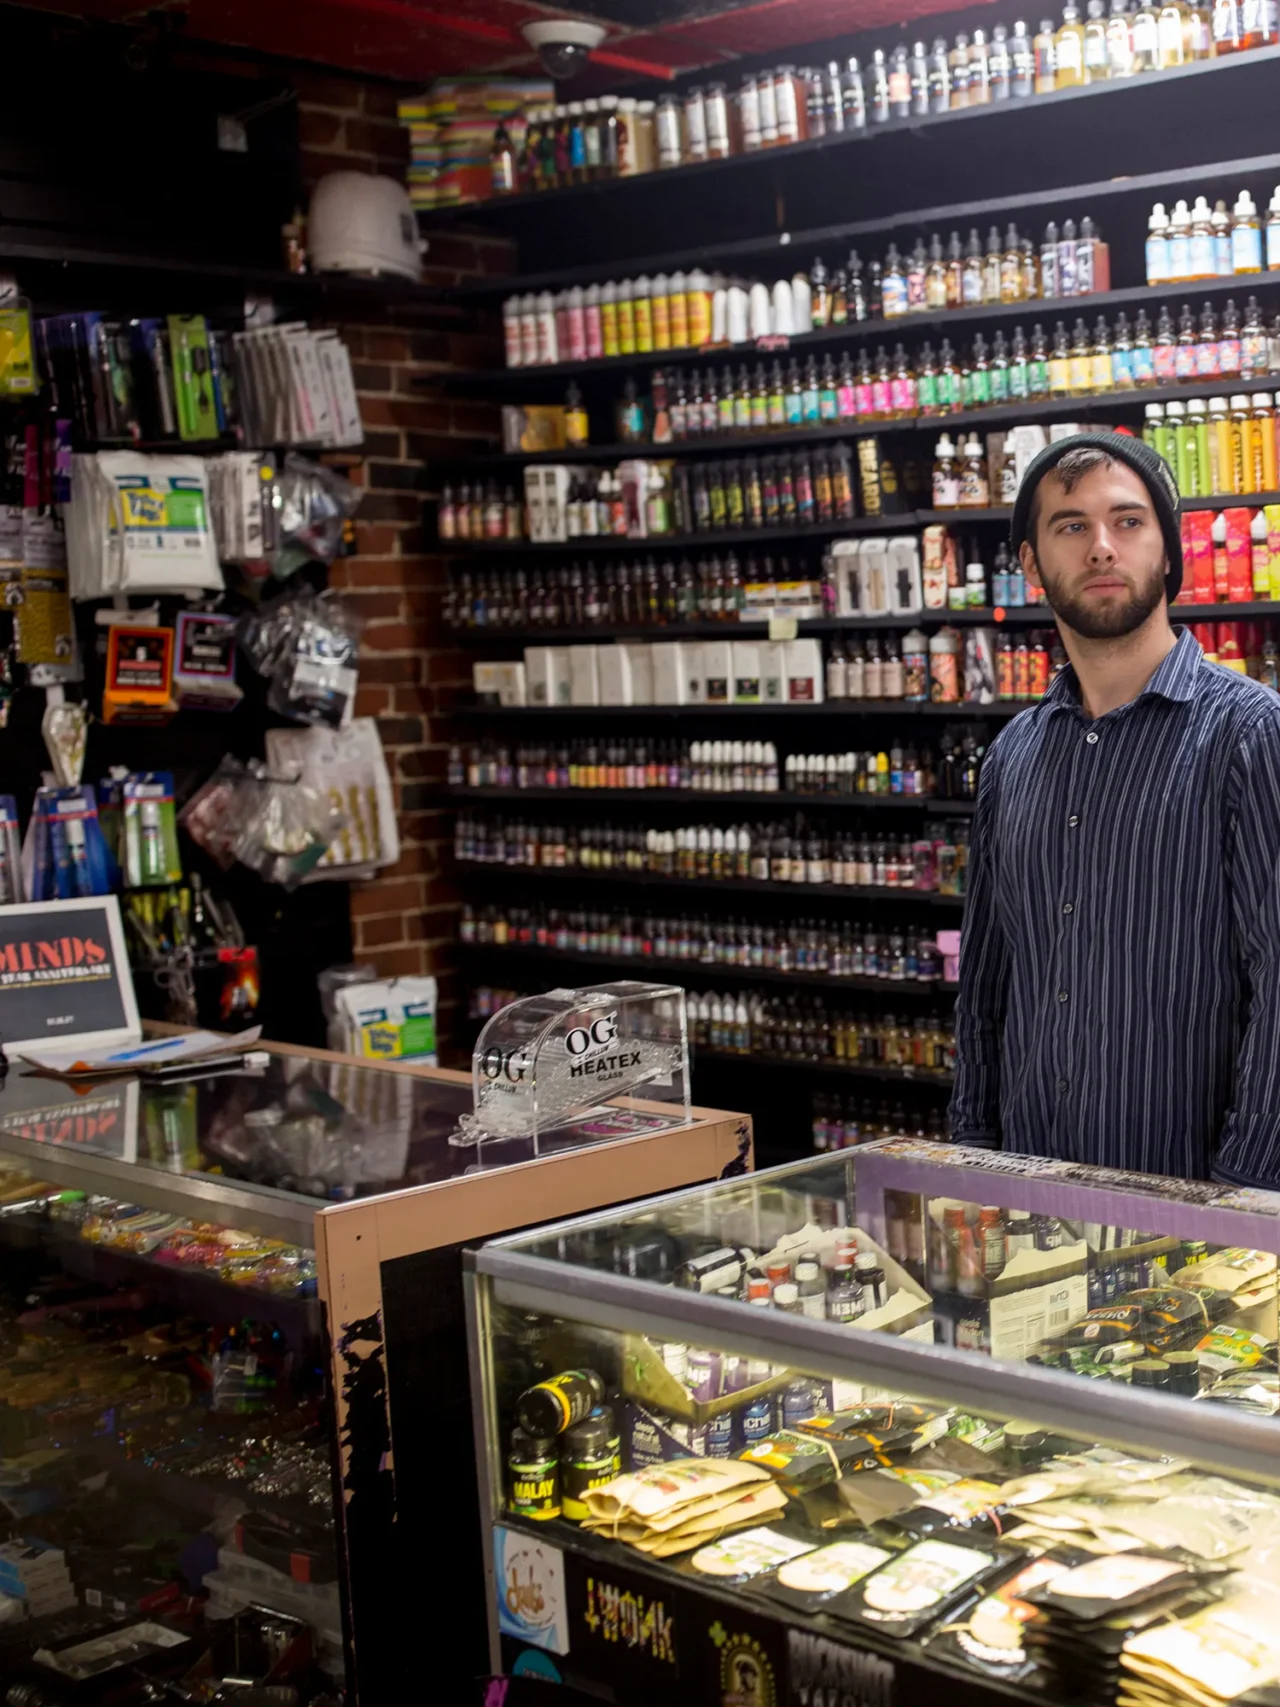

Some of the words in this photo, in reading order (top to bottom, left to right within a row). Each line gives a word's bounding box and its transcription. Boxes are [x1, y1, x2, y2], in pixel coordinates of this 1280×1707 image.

[34, 963, 111, 981] ANNIVERSARY
[565, 1013, 618, 1056] OG
[482, 1047, 528, 1083] OG
[571, 1050, 643, 1078] HEATEX
